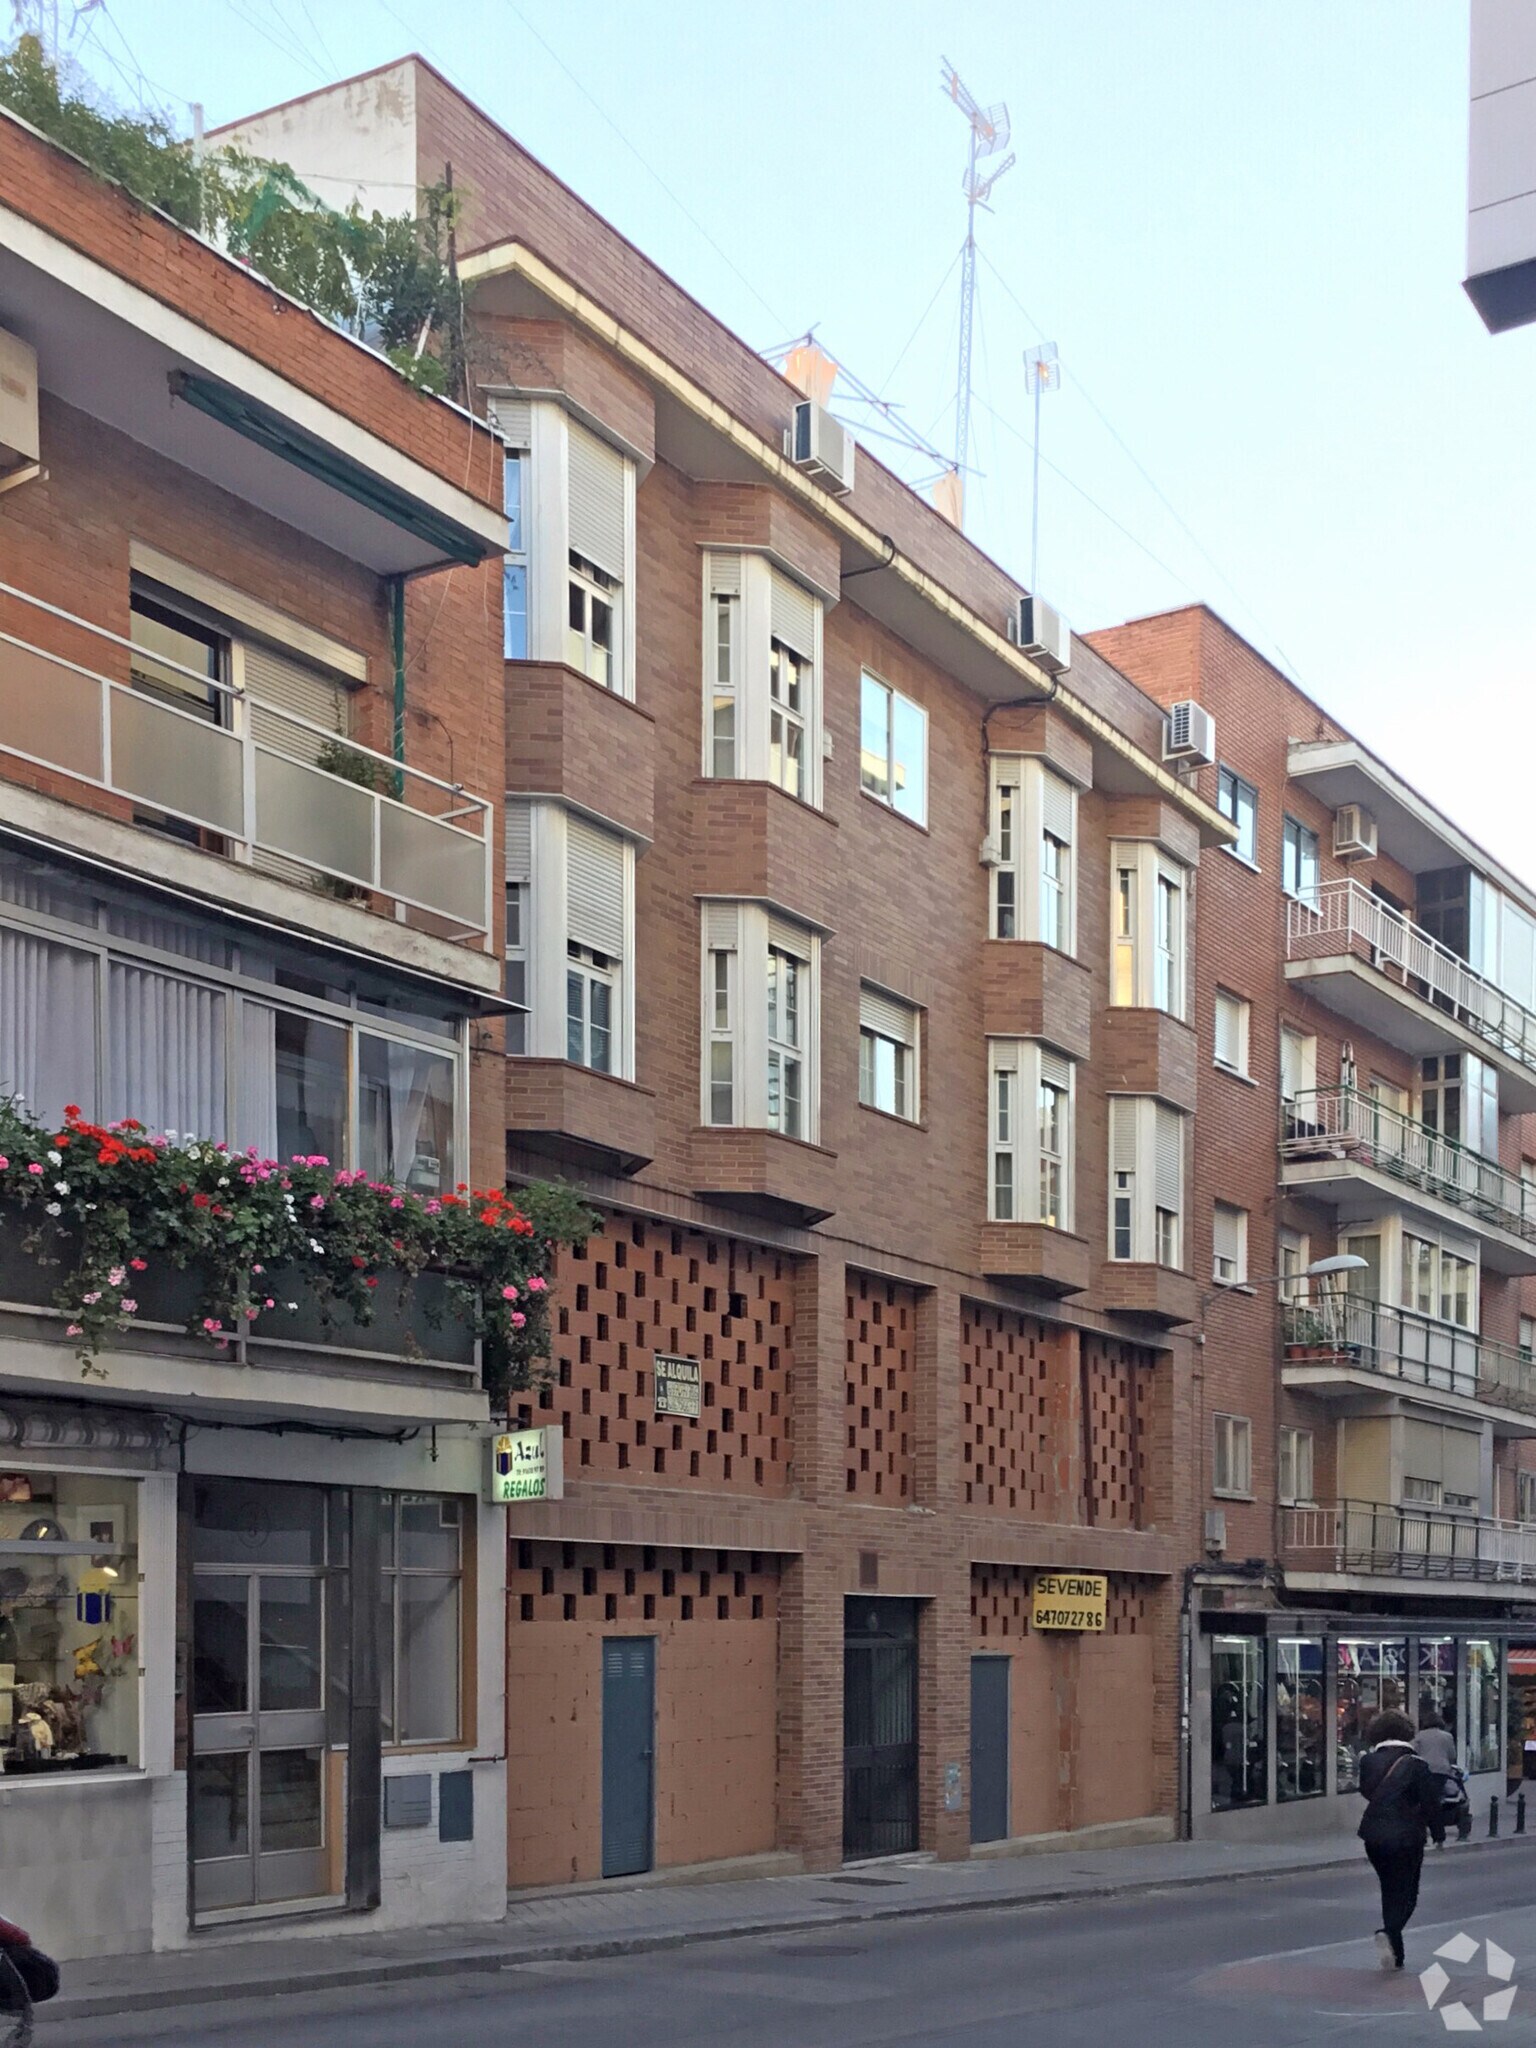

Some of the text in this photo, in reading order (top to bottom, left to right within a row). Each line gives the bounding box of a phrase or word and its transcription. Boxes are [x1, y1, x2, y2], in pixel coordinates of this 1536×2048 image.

[656, 1360, 699, 1382] SE ALQUILA
[503, 1478, 545, 1499] REGALOS
[1036, 1609, 1103, 1627] 647072786
